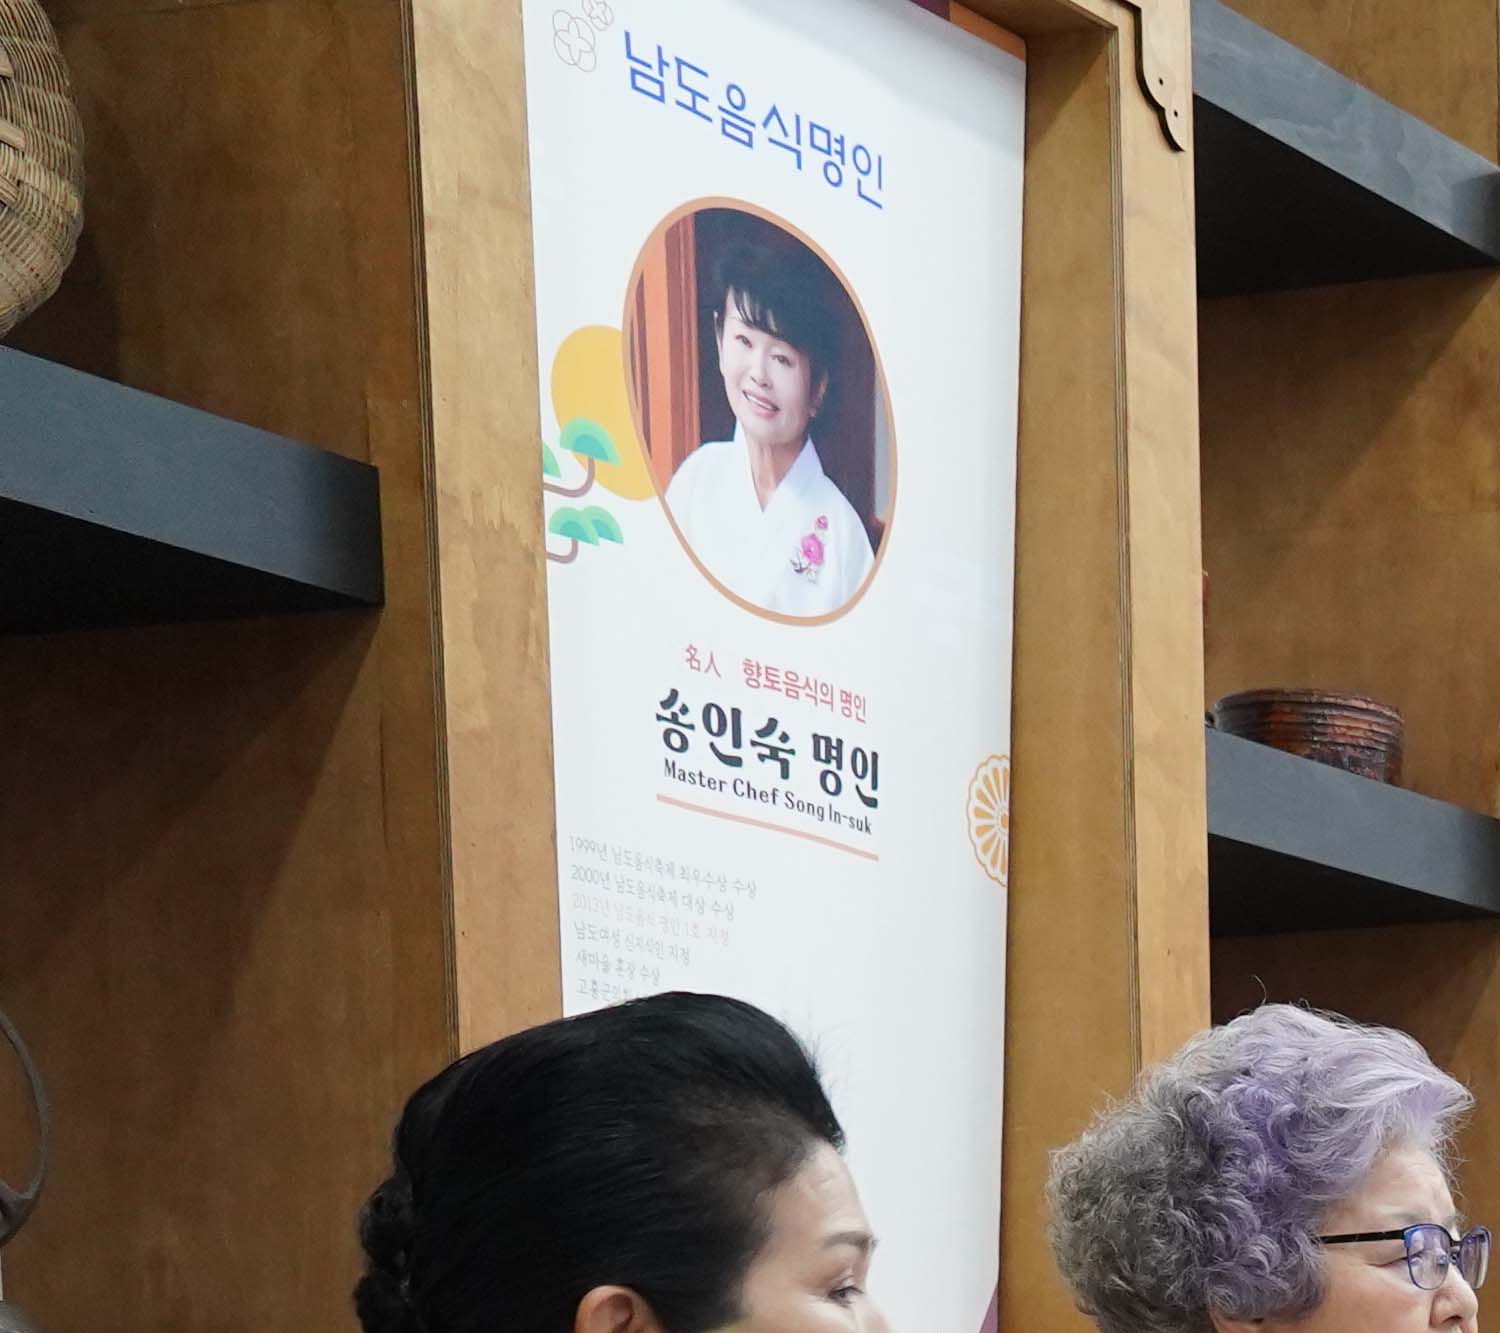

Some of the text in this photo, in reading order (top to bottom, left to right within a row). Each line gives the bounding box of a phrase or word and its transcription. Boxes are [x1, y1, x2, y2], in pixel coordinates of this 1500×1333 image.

[622, 29, 886, 210] 남도음식명인
[685, 643, 867, 724] 名人 향토음식의 명인
[655, 688, 879, 809] 송인숙 명인
[663, 757, 872, 836] Master Chef Song In-suk
[570, 862, 609, 890] 2000년
